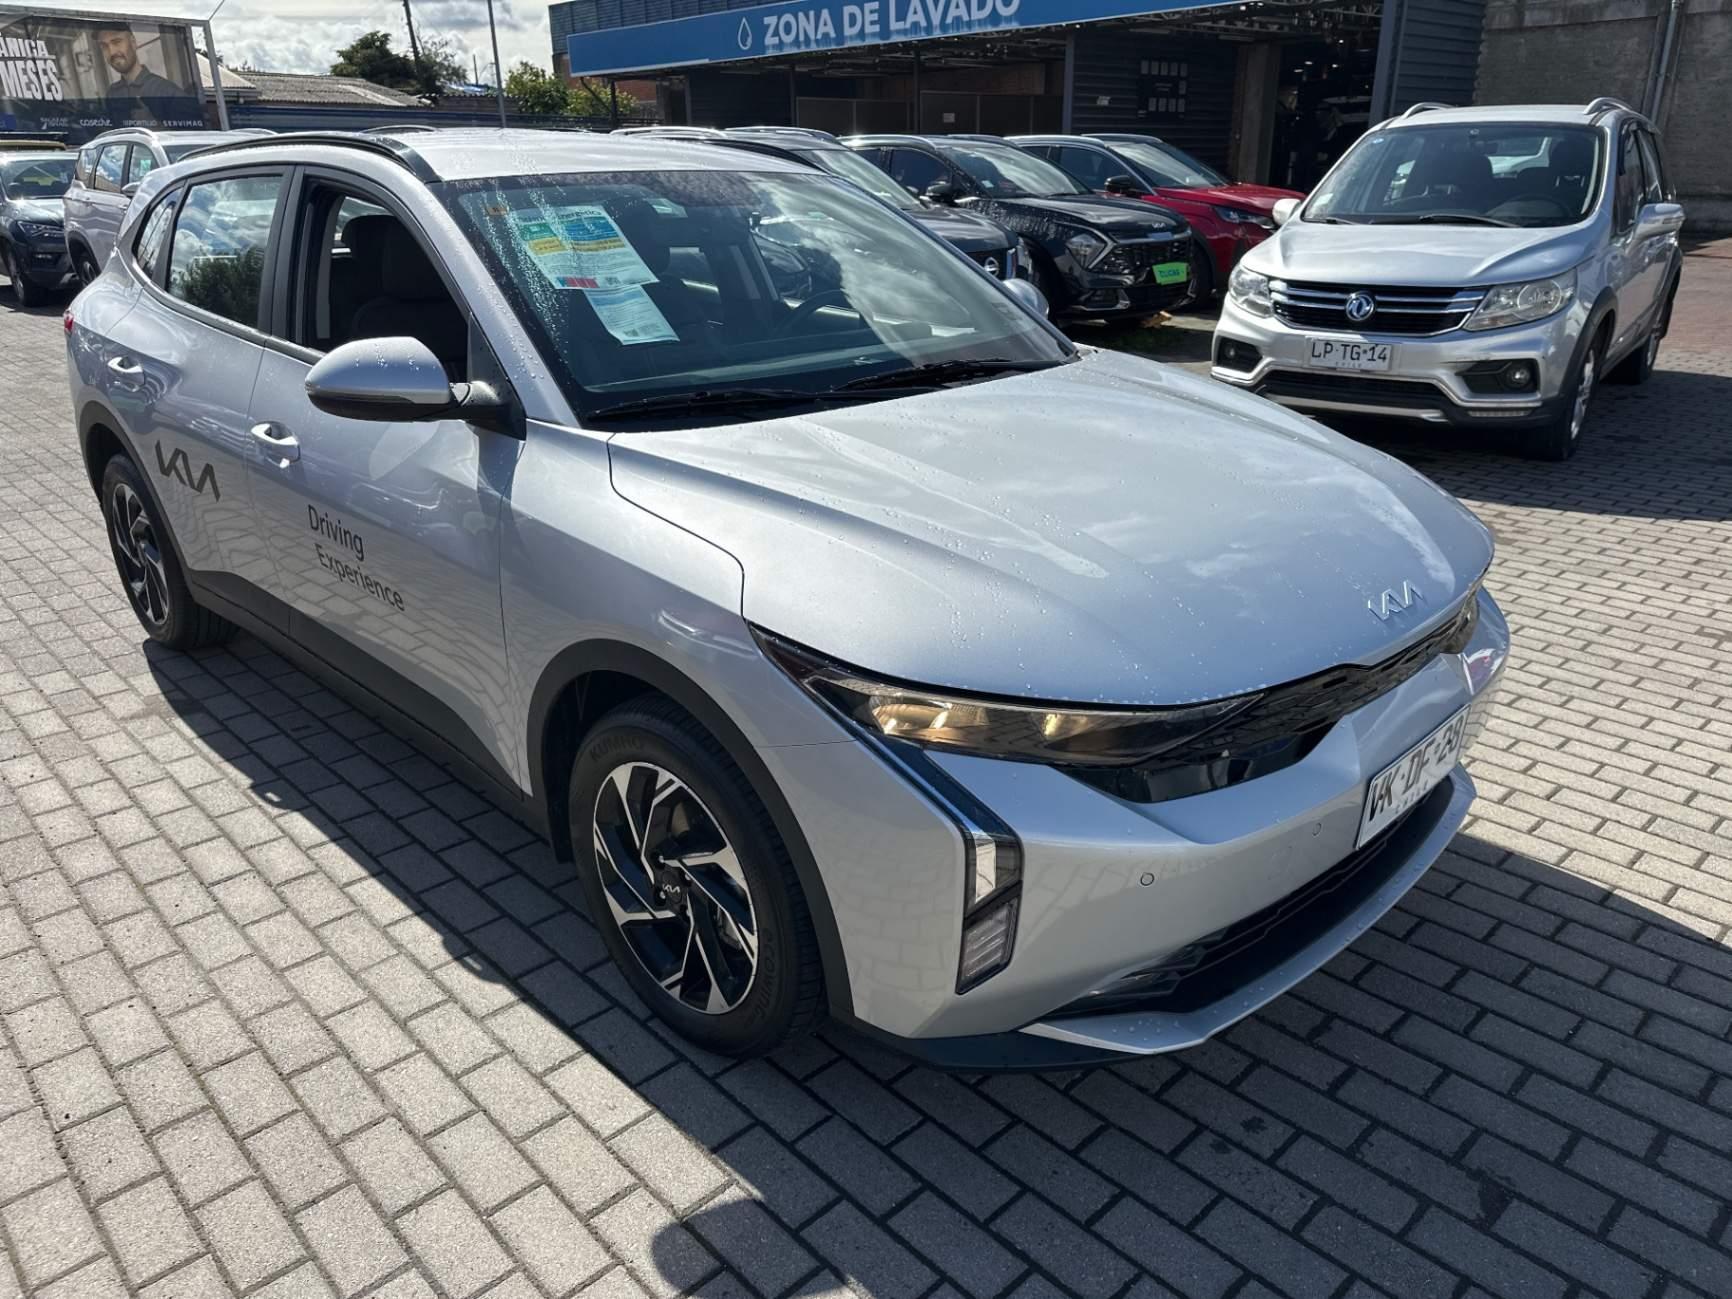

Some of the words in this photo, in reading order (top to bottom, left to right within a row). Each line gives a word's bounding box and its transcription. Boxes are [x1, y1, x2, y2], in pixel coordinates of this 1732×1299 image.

[763, 9, 836, 46] ZONA
[843, 2, 880, 36] DE
[889, 0, 1020, 32] LAVADO
[0, 60, 63, 101] MESES
[155, 440, 220, 501] KIA
[308, 504, 365, 562] Driving
[315, 543, 405, 611] Experience
